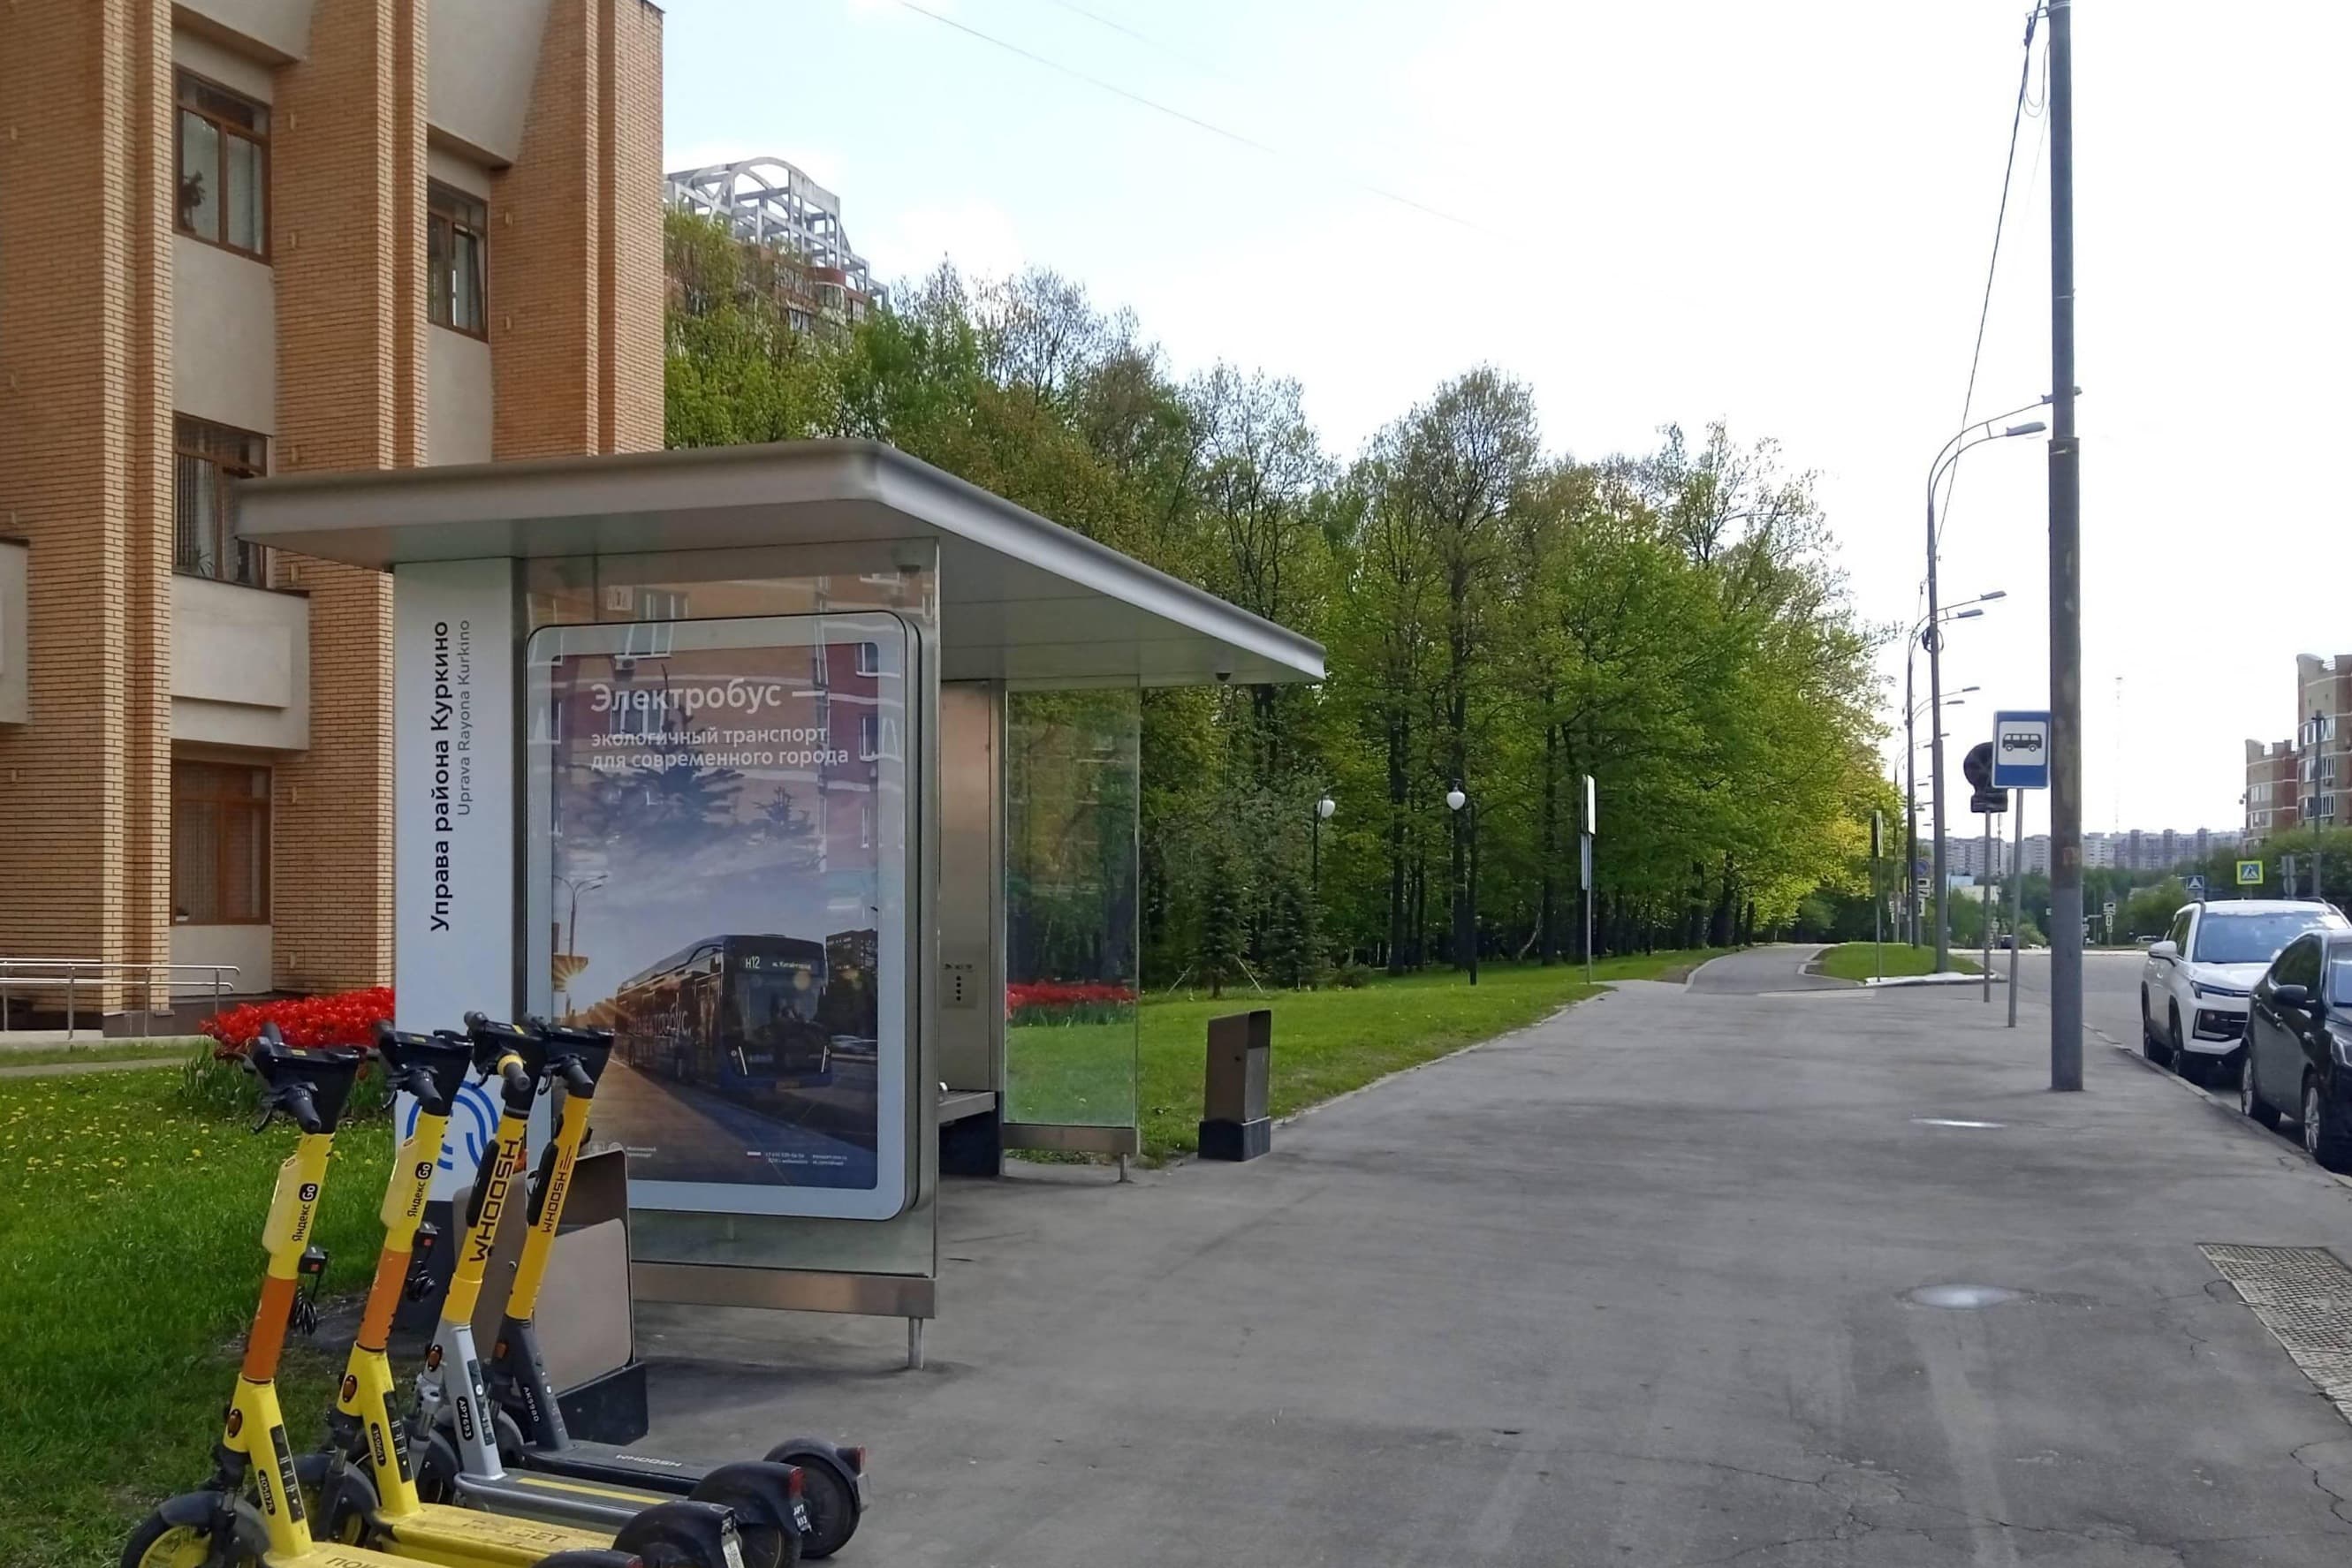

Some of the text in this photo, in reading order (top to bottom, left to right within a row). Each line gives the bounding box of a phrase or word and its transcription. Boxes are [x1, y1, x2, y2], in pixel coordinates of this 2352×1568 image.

[457, 619, 473, 815] Uprava Rayona Kurkino
[590, 678, 782, 716] Электробус
[591, 726, 828, 747] экологичный транспорт
[591, 748, 849, 772] для современного города
[430, 621, 452, 932] Управа района Куркино
[292, 1185, 316, 1242] Яндекс Go
[407, 1163, 432, 1218] Яндекс Go
[469, 1140, 520, 1261] WHOOSH
[541, 1171, 568, 1233] WHOOSH
